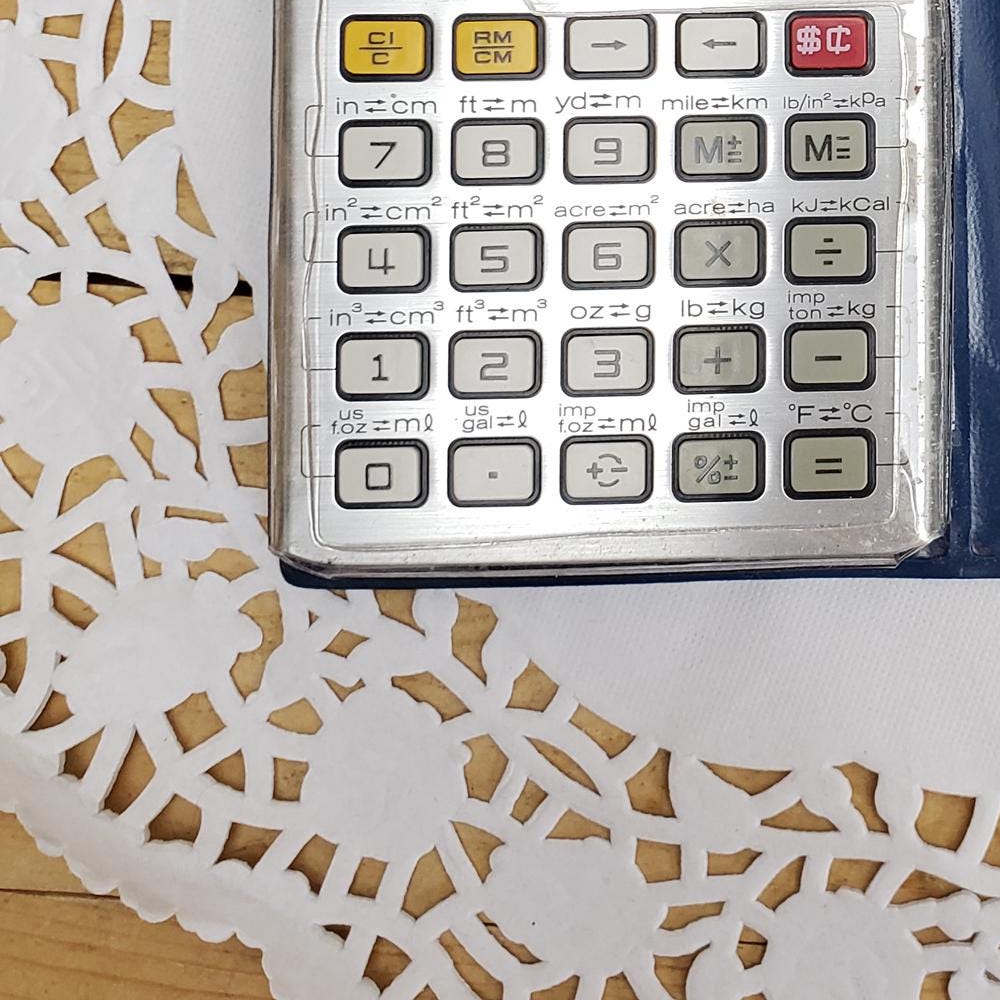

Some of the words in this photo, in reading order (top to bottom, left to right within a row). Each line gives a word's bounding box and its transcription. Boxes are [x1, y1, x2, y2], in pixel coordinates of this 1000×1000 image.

[474, 31, 513, 44] RM
[372, 52, 390, 65] C
[475, 51, 513, 63] CM
[371, 142, 396, 168] 7
[482, 139, 510, 167] 8
[595, 137, 621, 164] 9
[369, 248, 395, 275] 4
[481, 245, 509, 273] 5
[594, 243, 621, 270] 6
[372, 355, 388, 381] 1
[480, 353, 509, 380] 2
[594, 350, 621, 378] 3
[366, 463, 392, 490] 0
